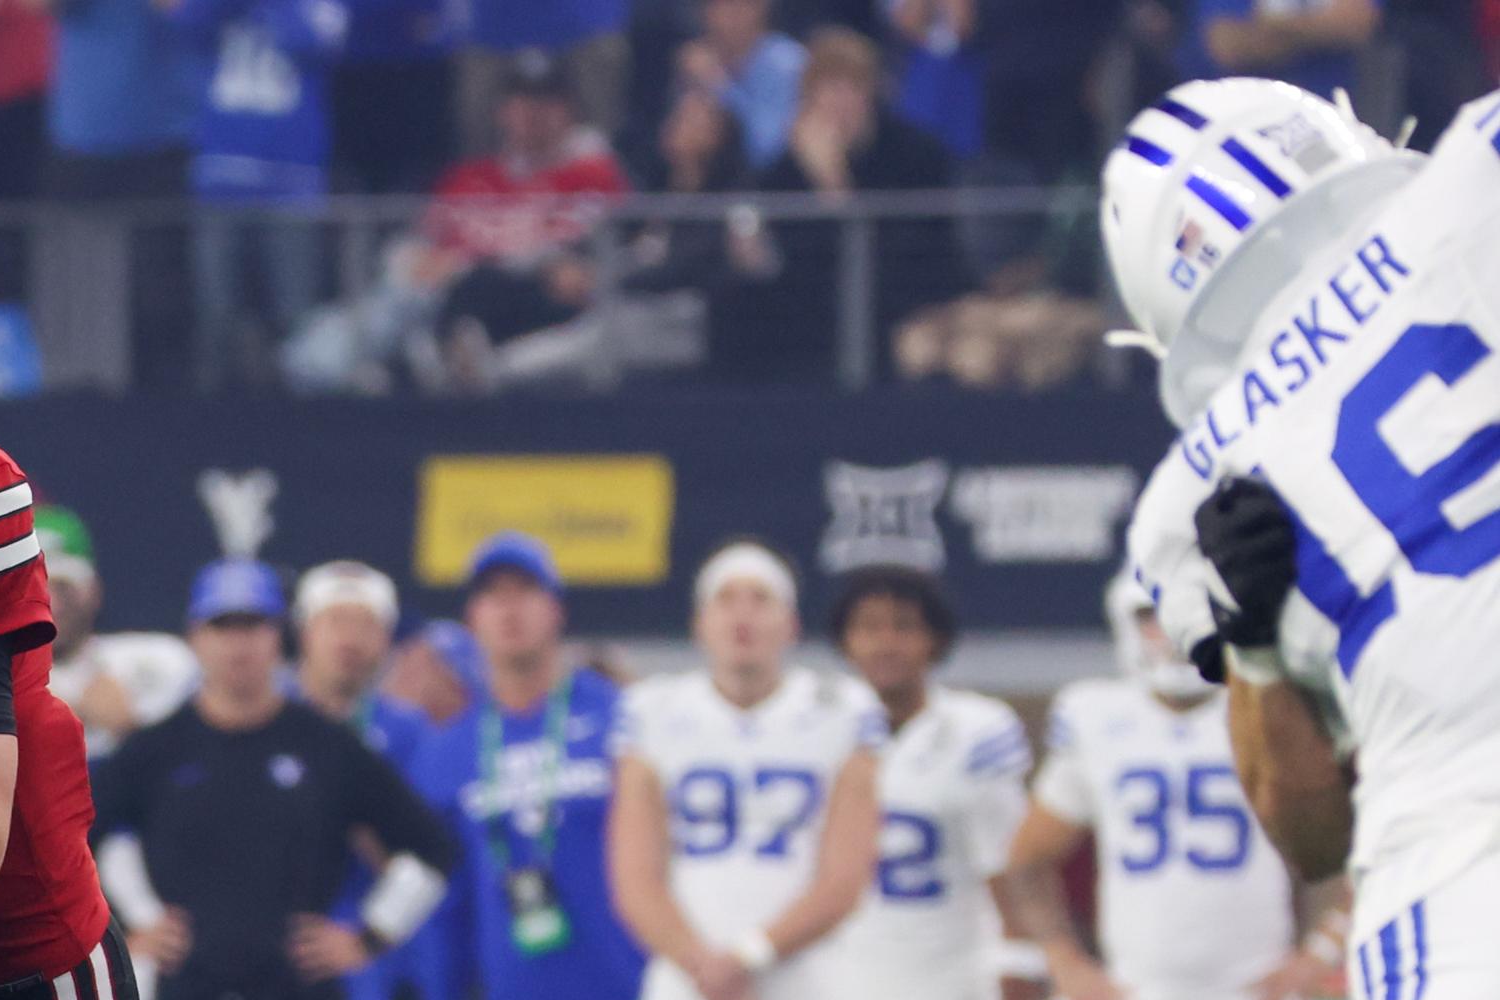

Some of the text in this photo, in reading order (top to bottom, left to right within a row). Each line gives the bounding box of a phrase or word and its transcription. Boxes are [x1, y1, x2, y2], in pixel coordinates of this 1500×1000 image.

[1183, 234, 1409, 481] GLASKER
[672, 768, 822, 856] 97
[1116, 765, 1251, 872] 35
